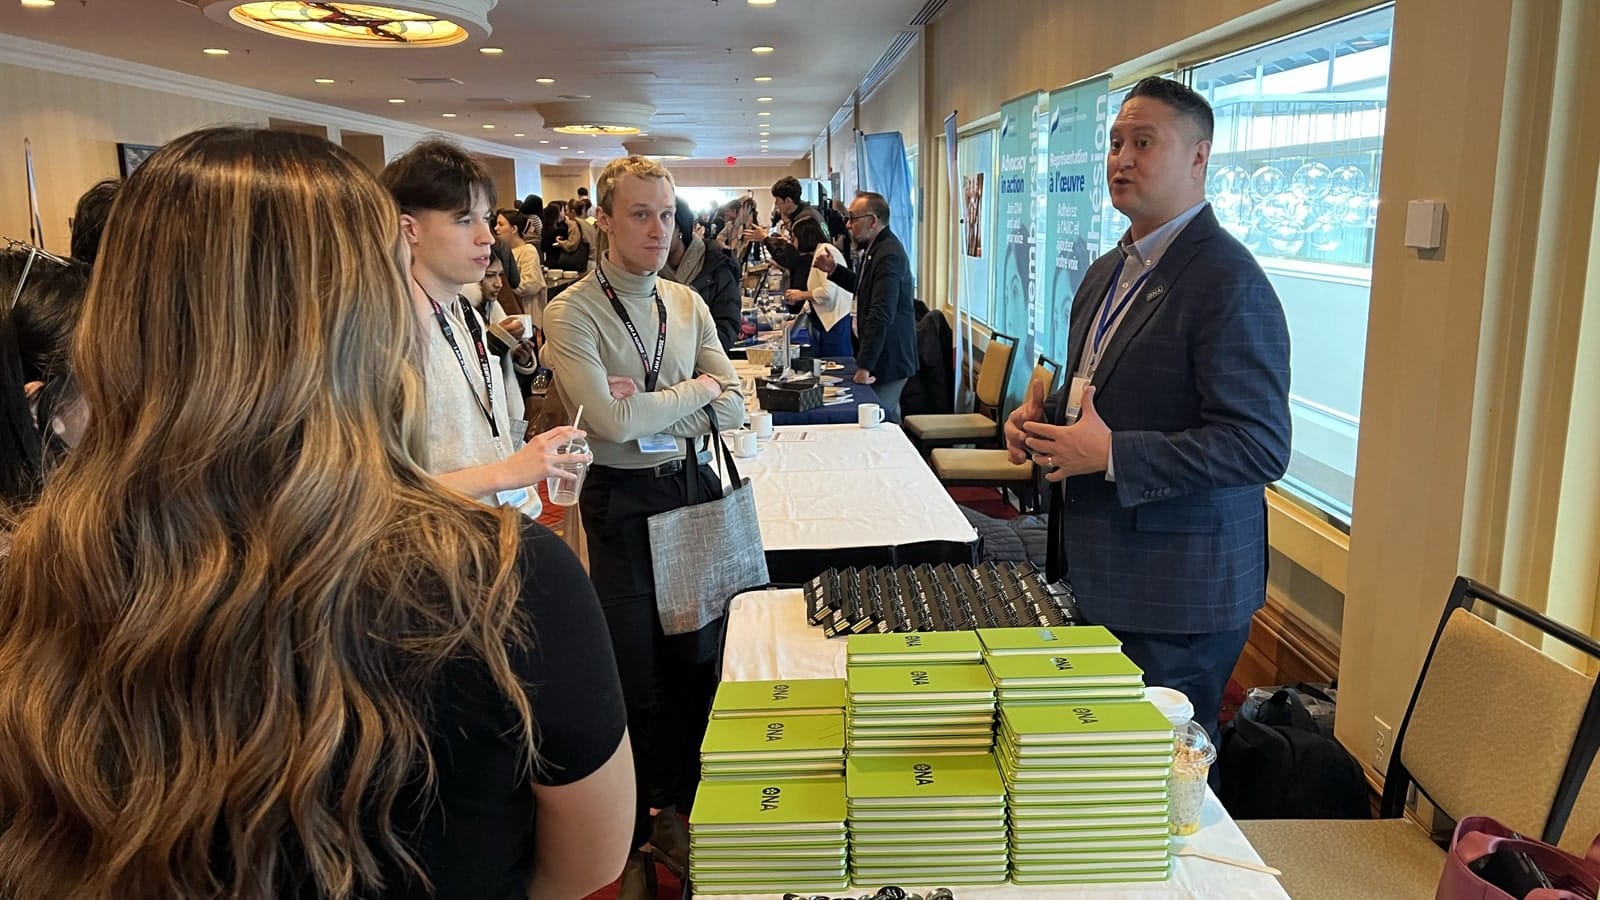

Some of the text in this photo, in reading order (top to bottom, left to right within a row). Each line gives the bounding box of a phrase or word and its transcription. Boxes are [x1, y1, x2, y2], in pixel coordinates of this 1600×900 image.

[1001, 153, 1027, 174] Advocacy
[1049, 148, 1088, 169] Représentation
[1001, 173, 1024, 193] in action
[1049, 171, 1085, 193] à l'œuvre
[1087, 94, 1107, 265] dhésion
[1027, 104, 1040, 336] membership
[910, 670, 930, 686] ONA
[772, 684, 790, 702] ONA
[1071, 707, 1099, 725] ONA
[766, 722, 785, 742] ONA
[913, 763, 935, 787] ONA
[760, 786, 781, 812] ONA
